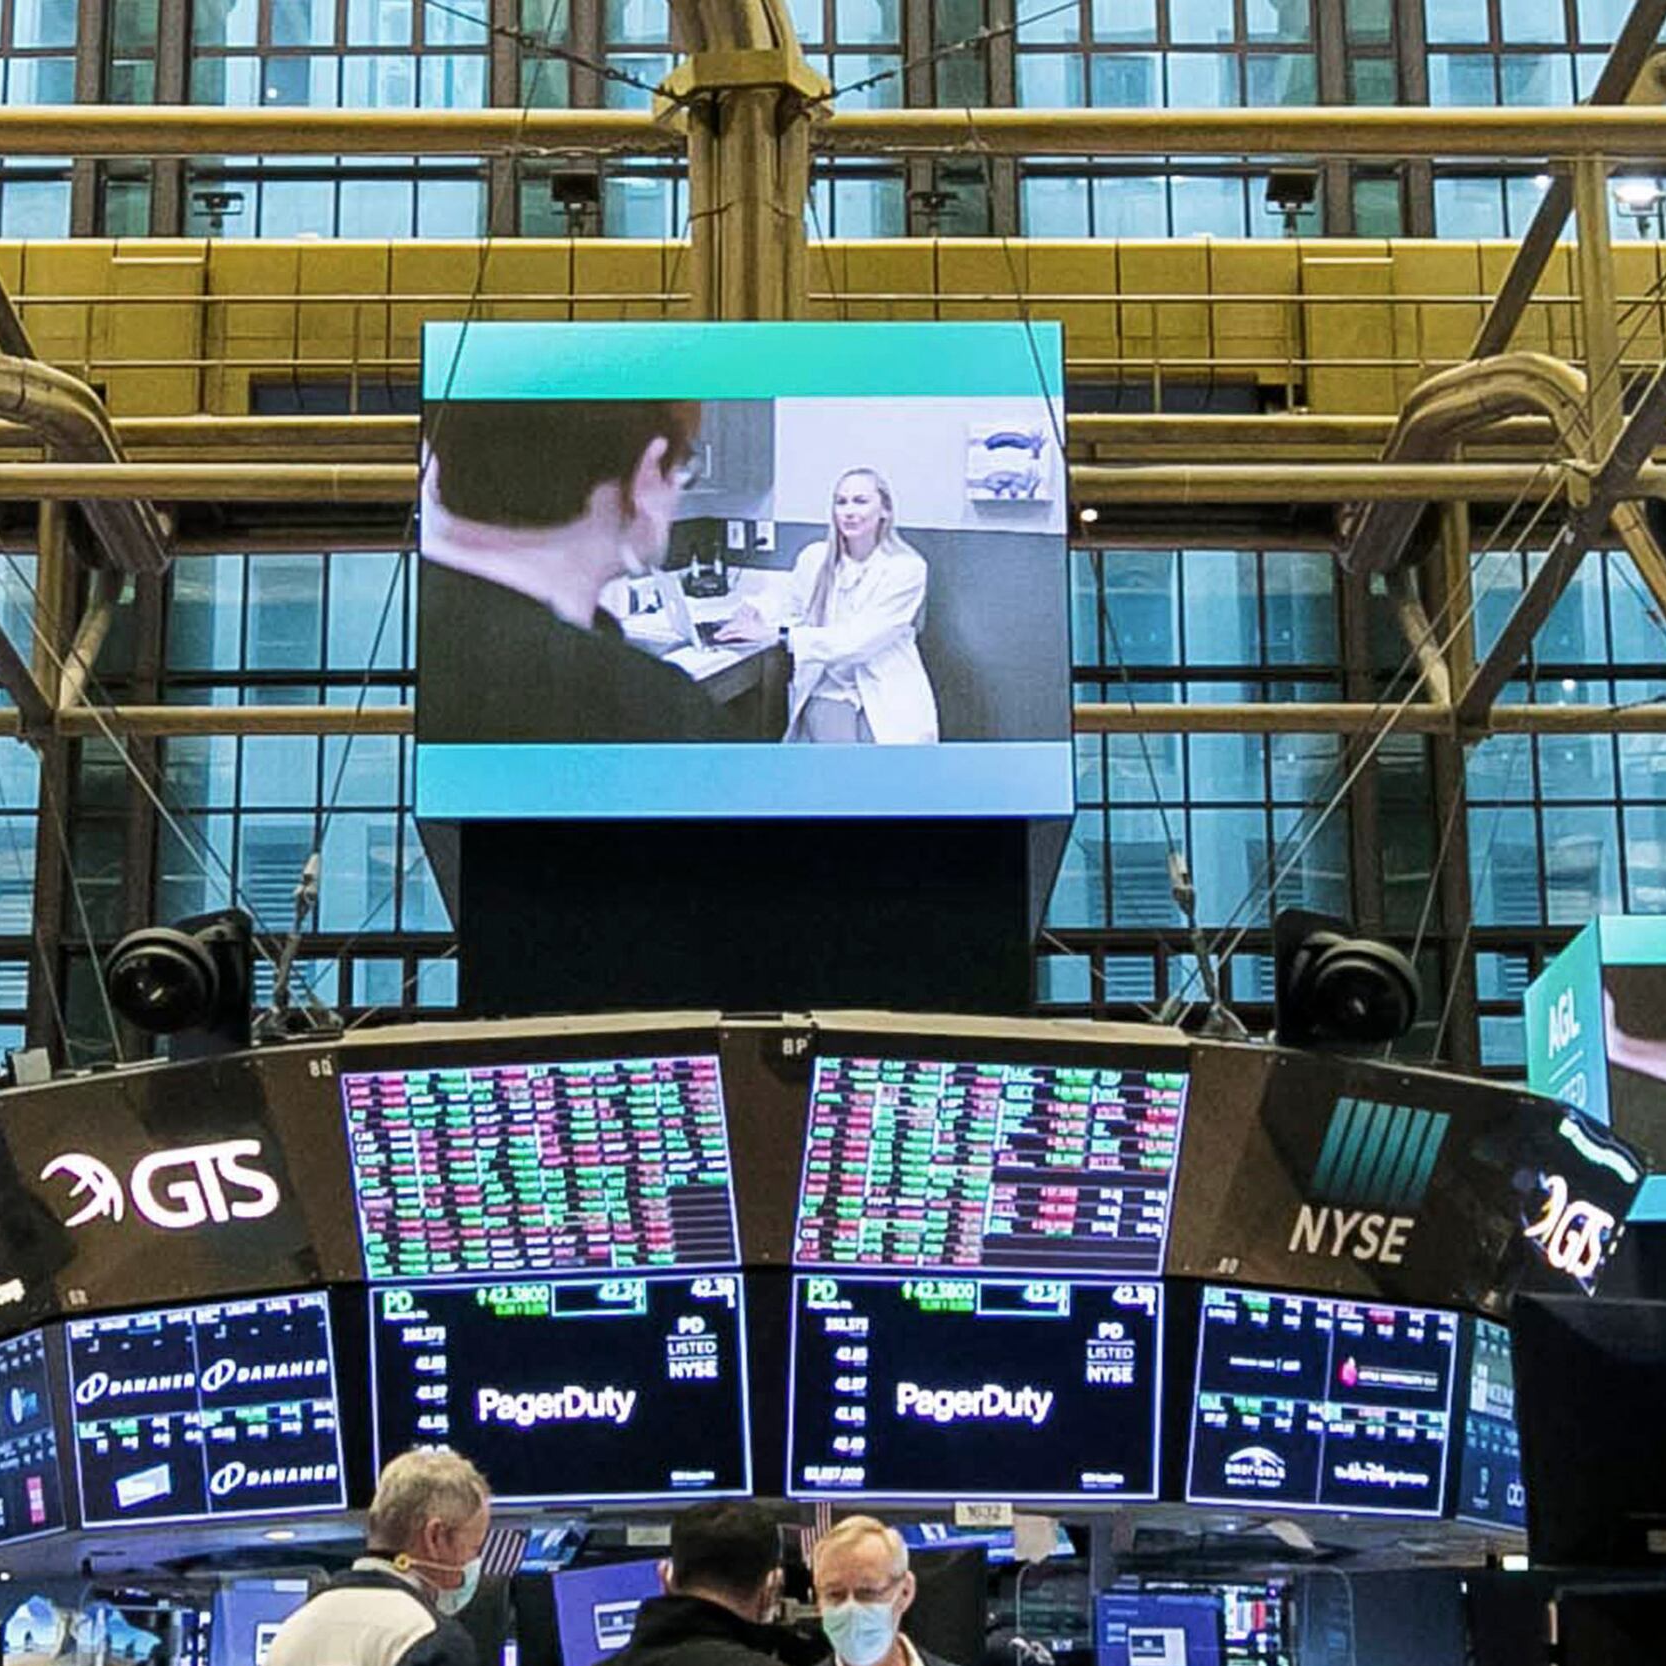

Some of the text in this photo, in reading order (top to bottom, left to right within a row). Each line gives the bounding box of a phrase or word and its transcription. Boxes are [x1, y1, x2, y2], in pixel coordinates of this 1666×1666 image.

[1548, 987, 1582, 1059] AGL
[132, 1139, 279, 1228] GTS
[1288, 1205, 1414, 1264] NYSE
[807, 1280, 835, 1299] PD
[383, 1291, 412, 1314] PD
[678, 1317, 704, 1334] PD
[1098, 1323, 1123, 1339] PD
[667, 1340, 717, 1355] LISTED
[1087, 1347, 1133, 1359] LISTED
[668, 1361, 718, 1378] NYSE
[1086, 1367, 1133, 1383] NYSE
[477, 1385, 636, 1427] PagerDuty
[896, 1382, 1053, 1422] PagerDuty
